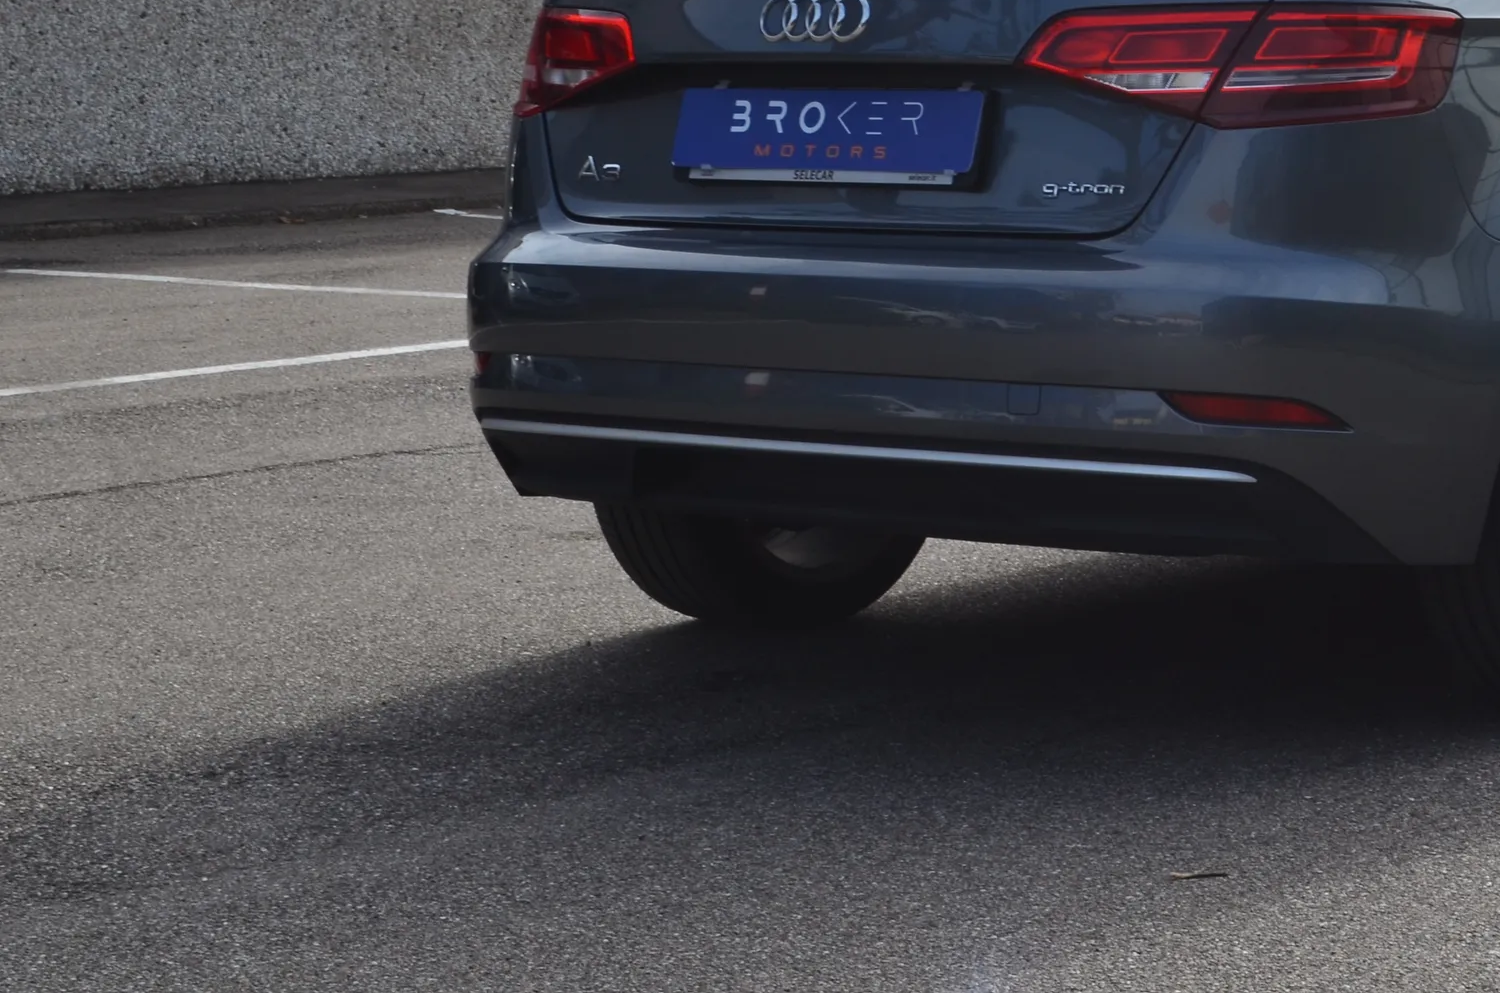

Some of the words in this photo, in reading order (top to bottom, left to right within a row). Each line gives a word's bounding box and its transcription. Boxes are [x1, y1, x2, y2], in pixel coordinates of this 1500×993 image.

[730, 100, 924, 135] BROKER
[753, 144, 887, 159] MOTORS
[578, 155, 621, 182] A3
[793, 169, 834, 181] SELECAR
[1042, 181, 1125, 198] g-tron
